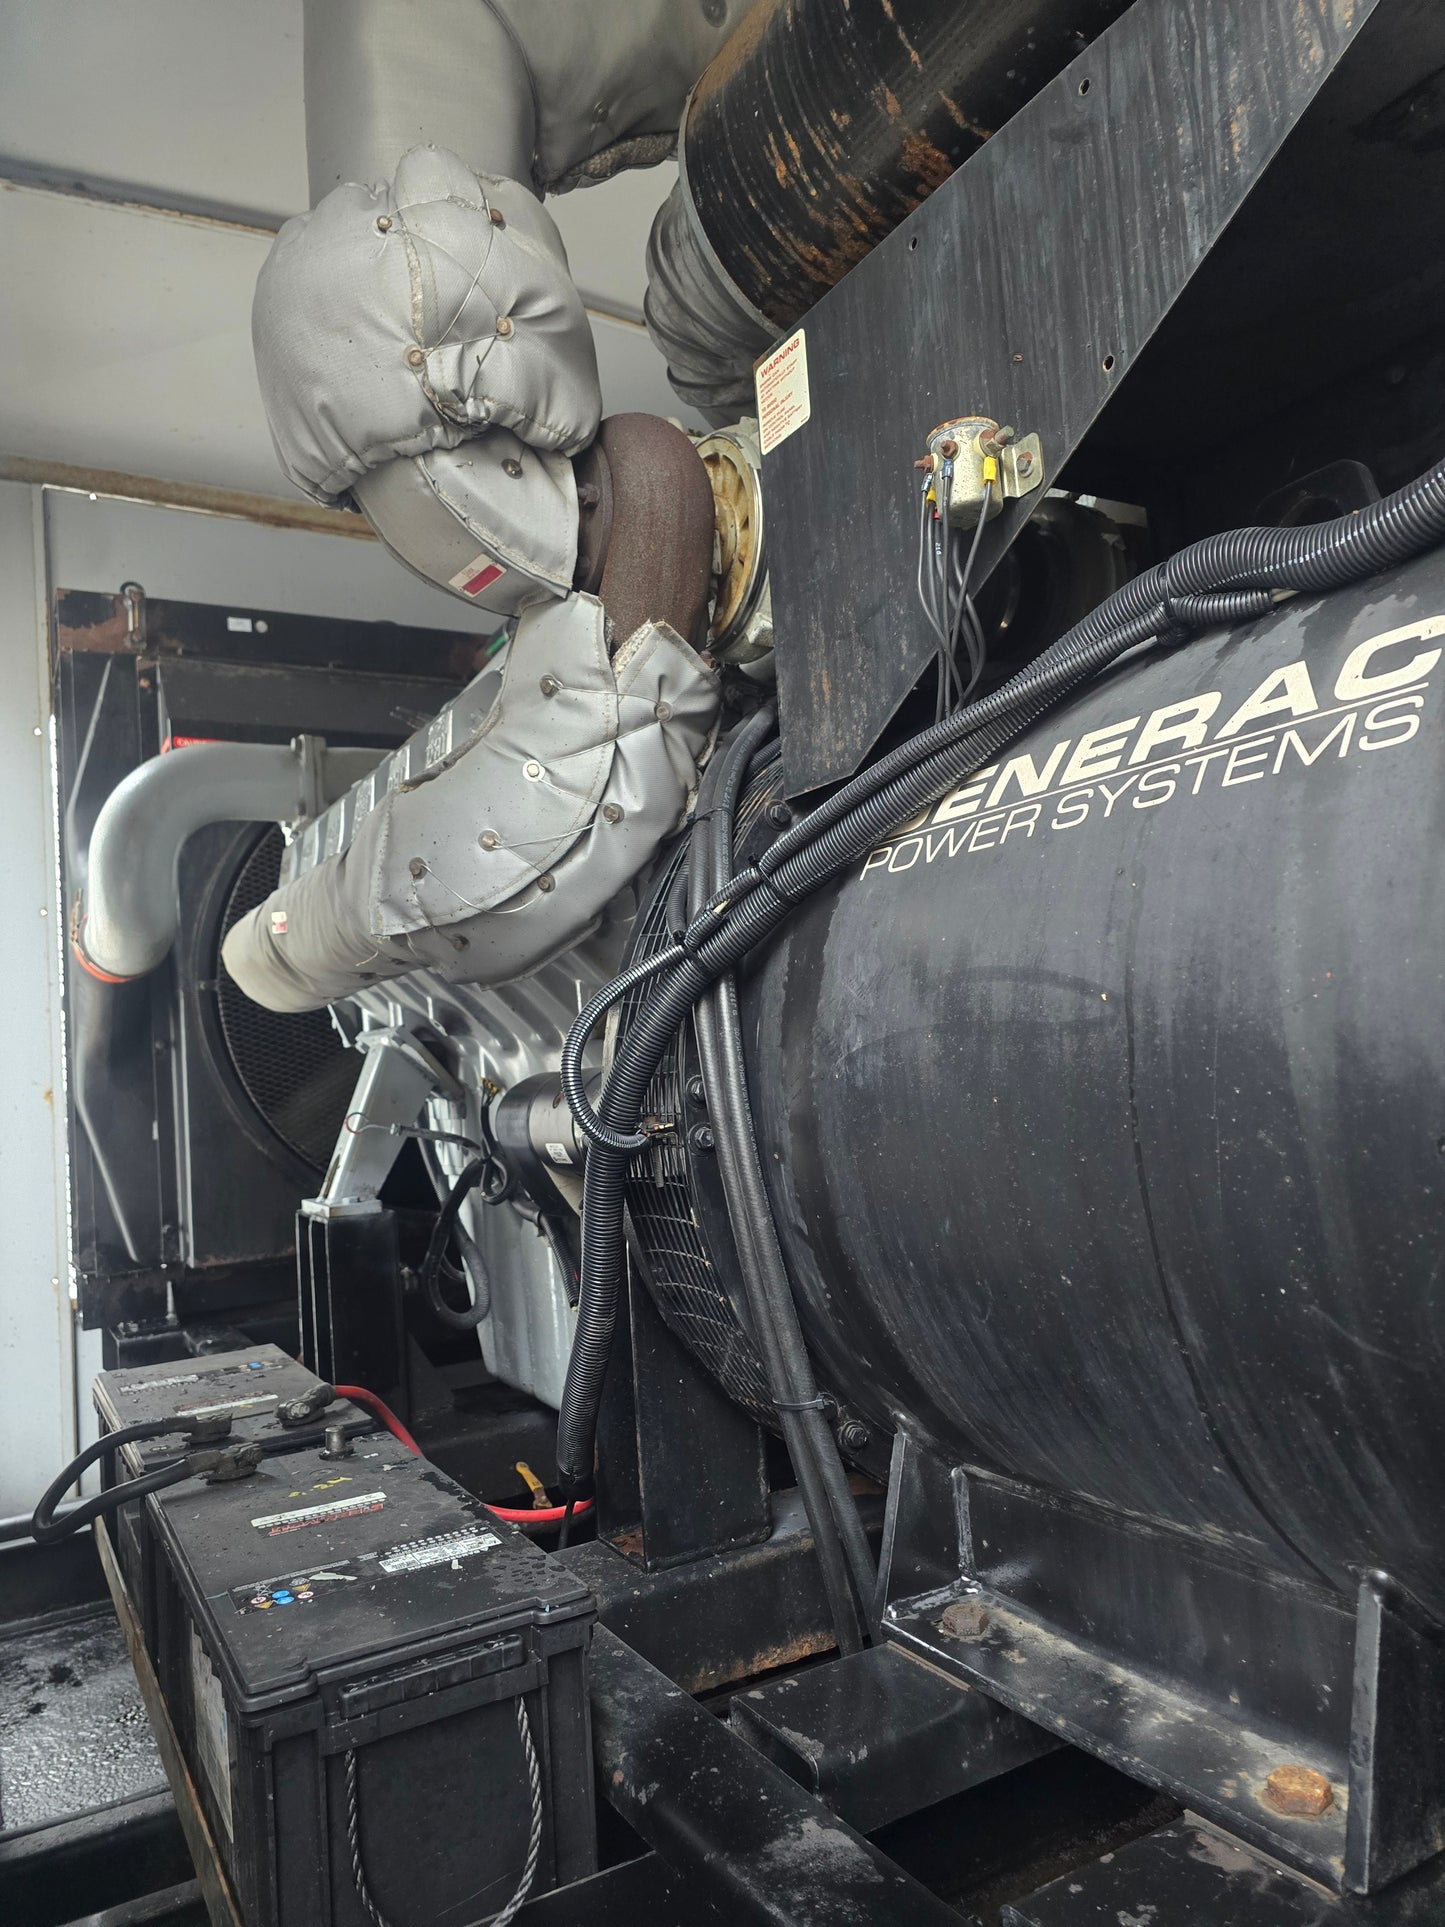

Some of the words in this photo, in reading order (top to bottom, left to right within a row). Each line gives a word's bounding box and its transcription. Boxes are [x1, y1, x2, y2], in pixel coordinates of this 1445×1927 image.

[760, 337, 800, 378] WARNING
[859, 803, 1048, 882] POWER
[1050, 694, 1427, 832] SYSTEMS
[893, 614, 1445, 838] ENERAC
